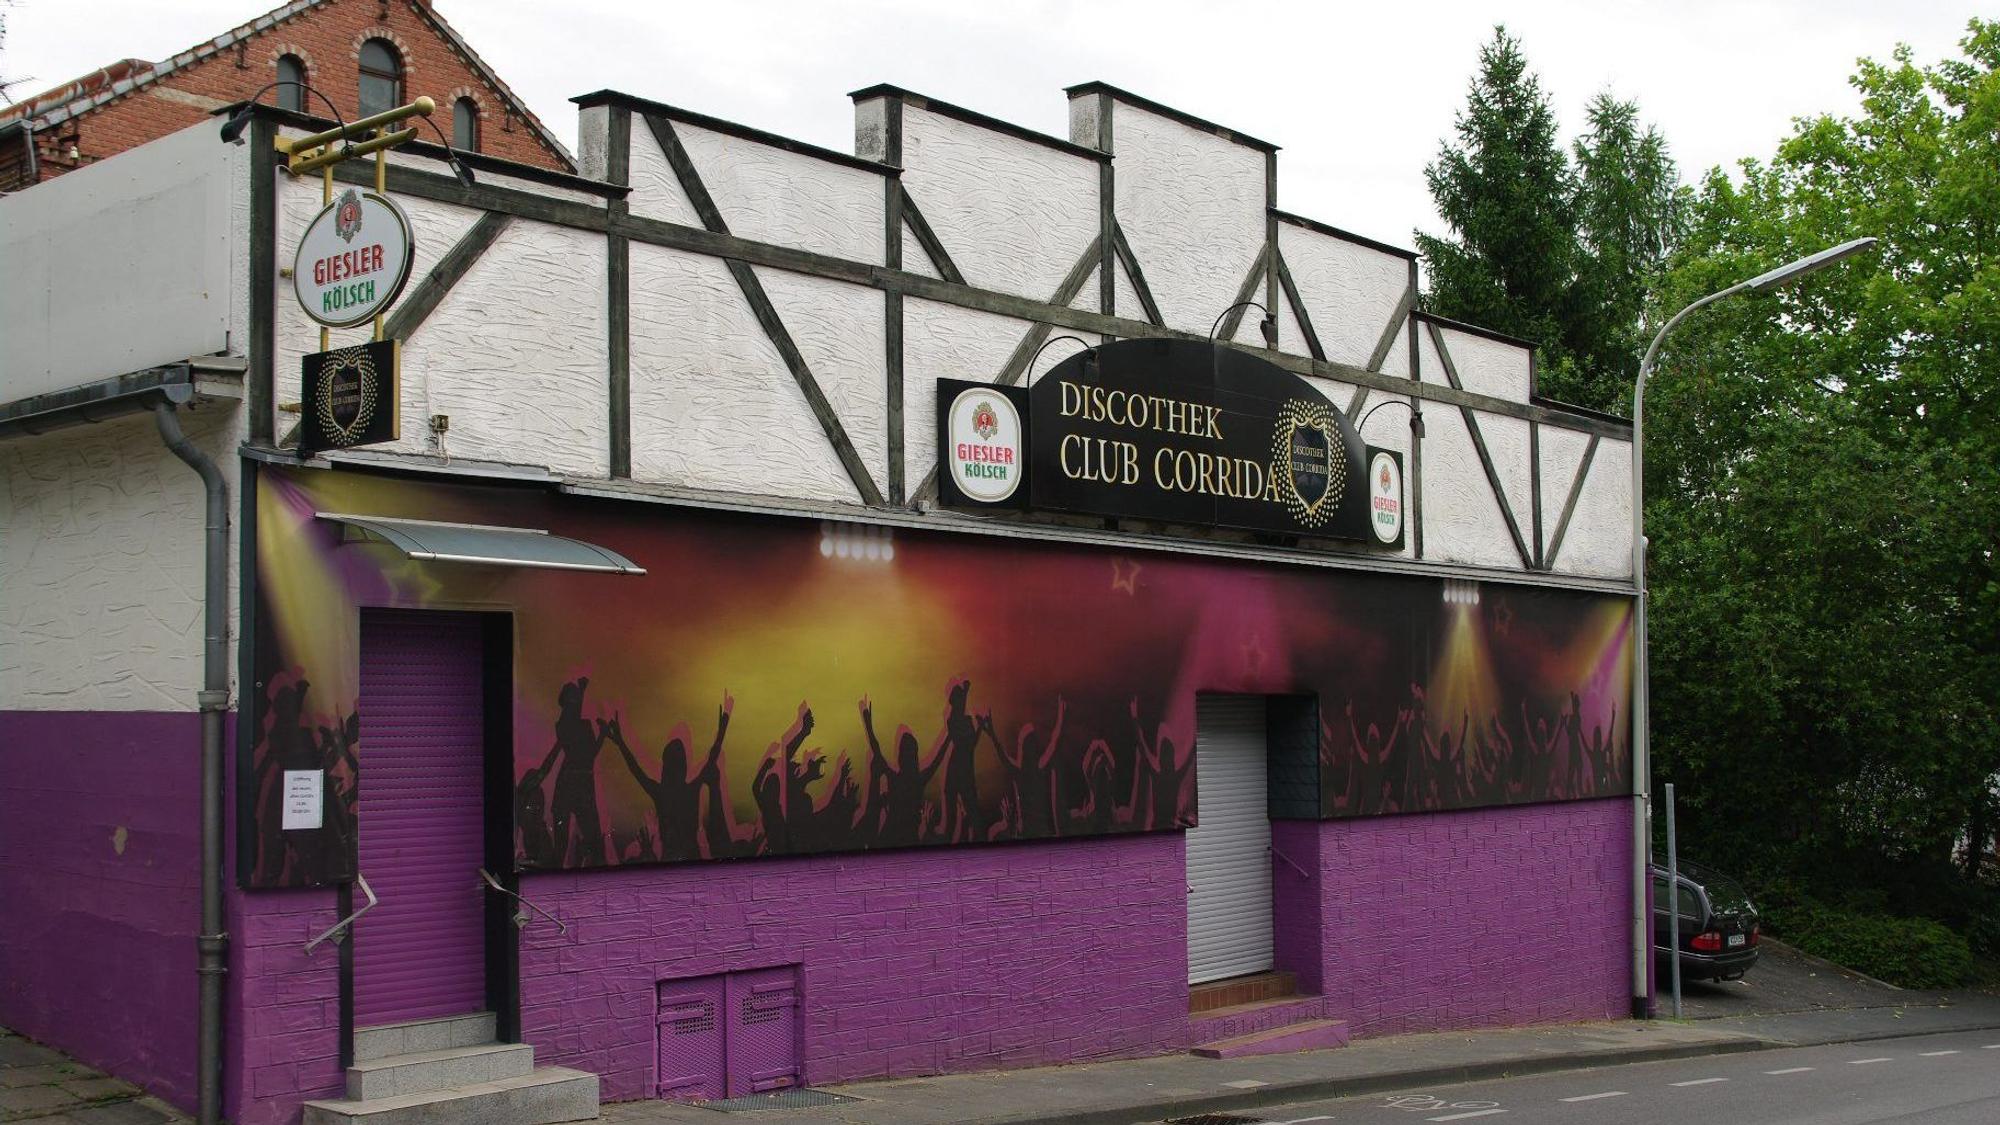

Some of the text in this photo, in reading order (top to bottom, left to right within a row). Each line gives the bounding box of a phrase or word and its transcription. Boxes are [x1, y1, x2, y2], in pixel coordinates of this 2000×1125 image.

[313, 244, 384, 286] GIESLER
[323, 280, 375, 313] KÖLSCH
[1059, 381, 1223, 440] DISCOTHEK
[957, 443, 1014, 464] GIESLER
[1060, 434, 1281, 502] CLUB CORRIDA
[964, 462, 1007, 480] KÖLSCH
[1374, 496, 1397, 513] GIESLER
